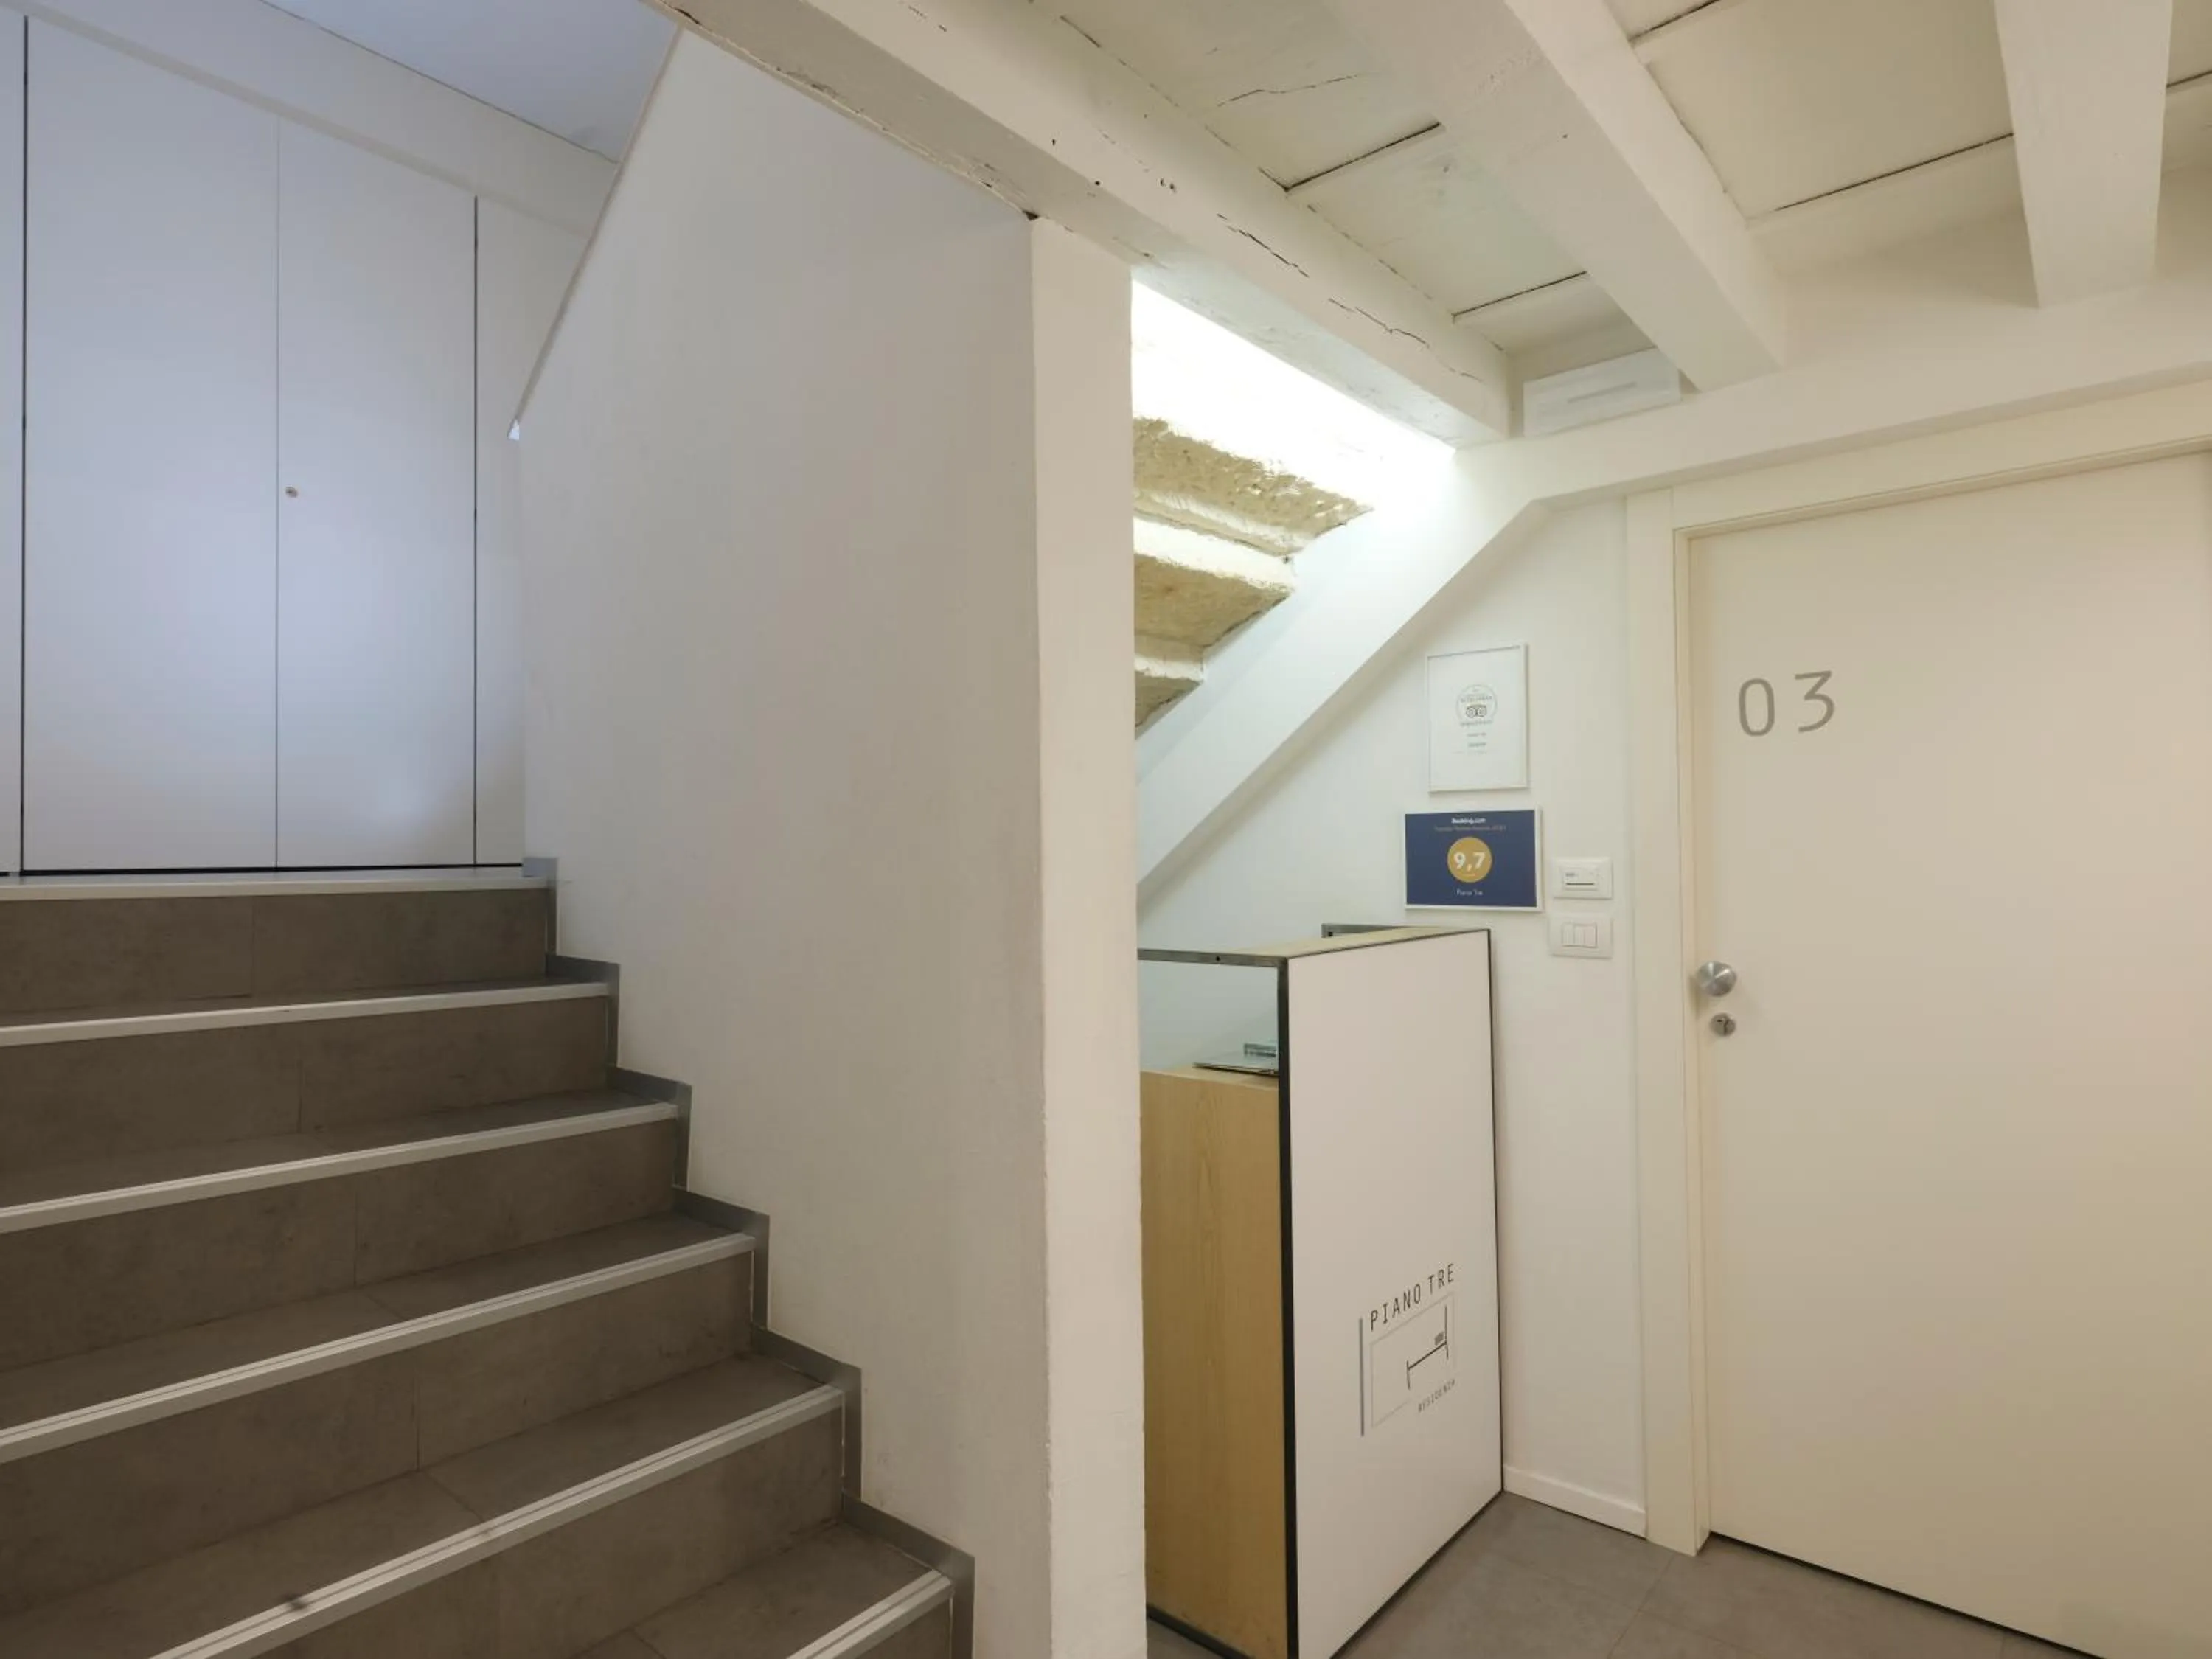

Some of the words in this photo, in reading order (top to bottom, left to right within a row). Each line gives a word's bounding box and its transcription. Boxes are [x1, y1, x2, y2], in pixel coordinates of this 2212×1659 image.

[1739, 670, 1834, 737] 03
[1453, 852, 1486, 872] 9,7
[1371, 1283, 1421, 1332] PIANO
[1427, 1263, 1454, 1295] TRE
